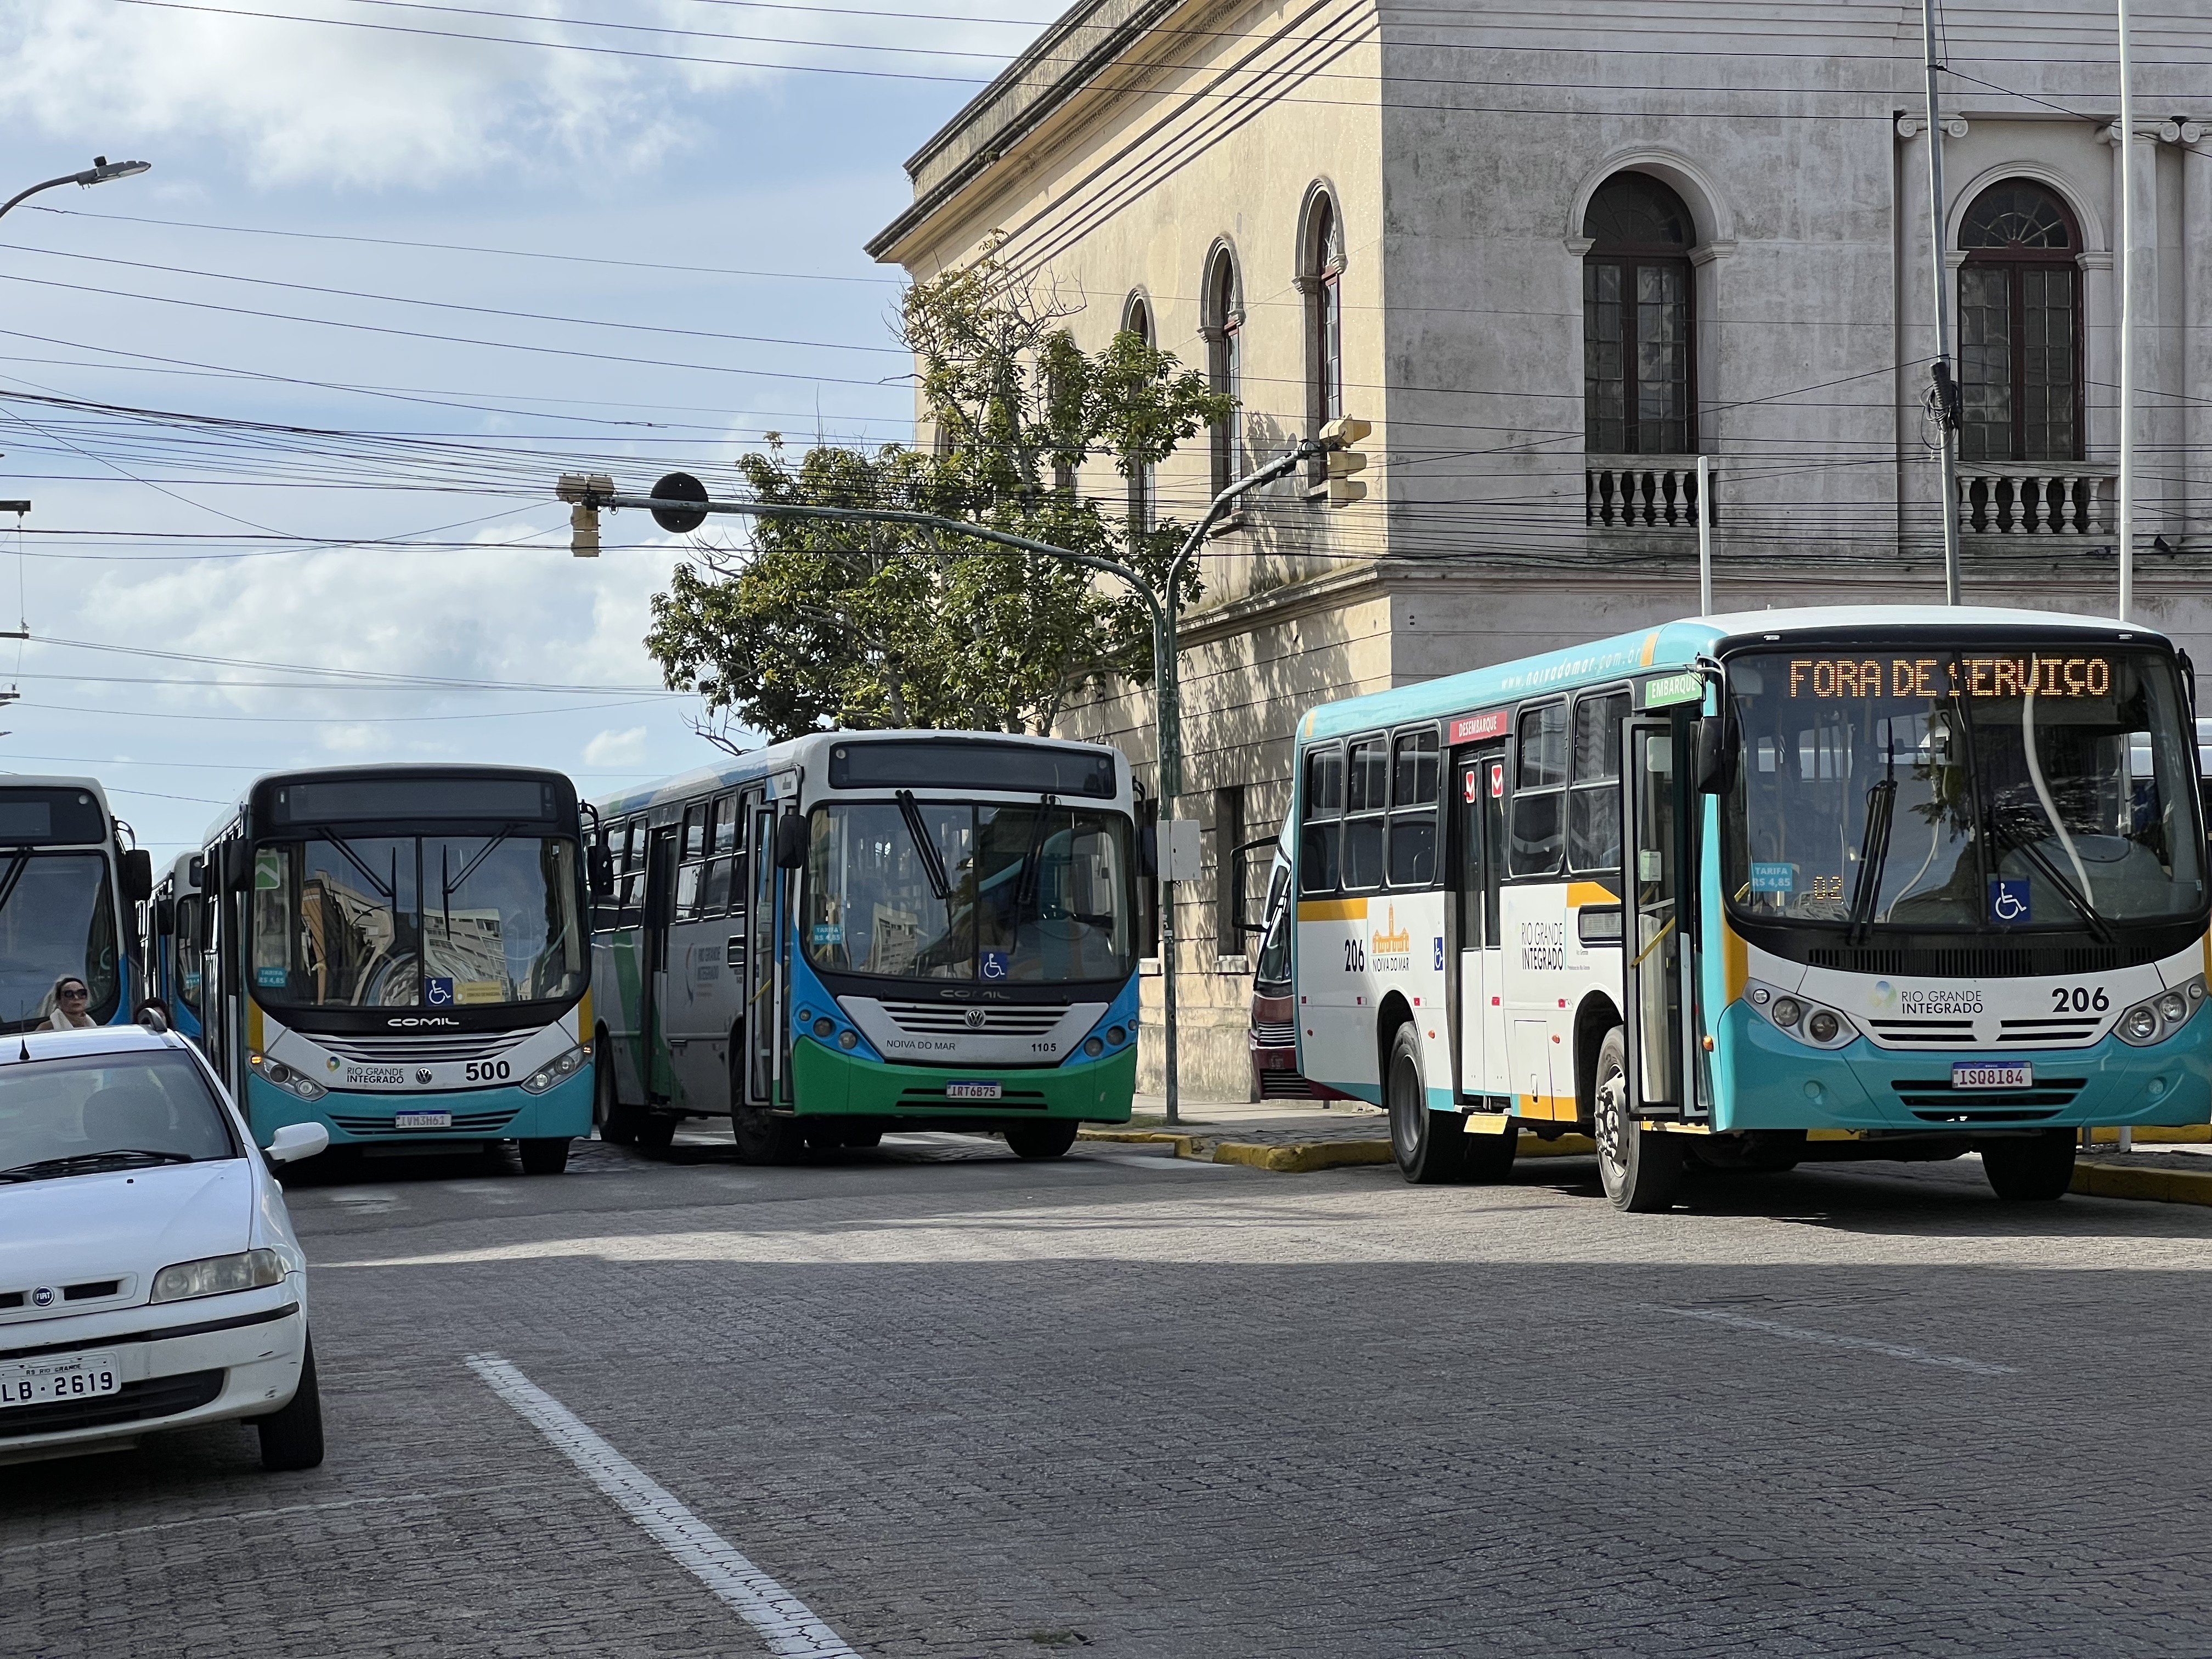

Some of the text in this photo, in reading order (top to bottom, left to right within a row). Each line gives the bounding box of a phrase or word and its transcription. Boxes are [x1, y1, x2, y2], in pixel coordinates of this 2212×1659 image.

[1791, 660, 1882, 697] FORA
[1893, 659, 1937, 696] DE
[1651, 675, 1696, 698] EMBARQUE
[1459, 715, 1497, 737] DESEMBARQUE
[1755, 867, 1788, 875] TARIFA
[1768, 878, 1791, 888] 4,85
[1813, 876, 1842, 900] 02
[1521, 922, 1562, 946] RIO GRANDE
[1344, 939, 1365, 972] 206
[1521, 947, 1564, 970] INTEGRADO
[1373, 957, 1409, 972] NOIVA DO MAR
[1901, 990, 1982, 1002] RIO GRANDE
[2052, 986, 2109, 1013] 206
[1902, 1002, 1983, 1014] INTEGRADO
[387, 1018, 459, 1026] COMIL
[887, 1040, 915, 1049] NOIVA
[918, 1041, 932, 1049] DO
[1031, 1043, 1057, 1052] 1105
[347, 1067, 404, 1076] RIO GRANDE
[466, 1060, 510, 1081] 500
[1959, 1069, 2023, 1085] ISQ8I84
[347, 1075, 404, 1084] INTEGRADO
[36, 1292, 50, 1300] FIAT
